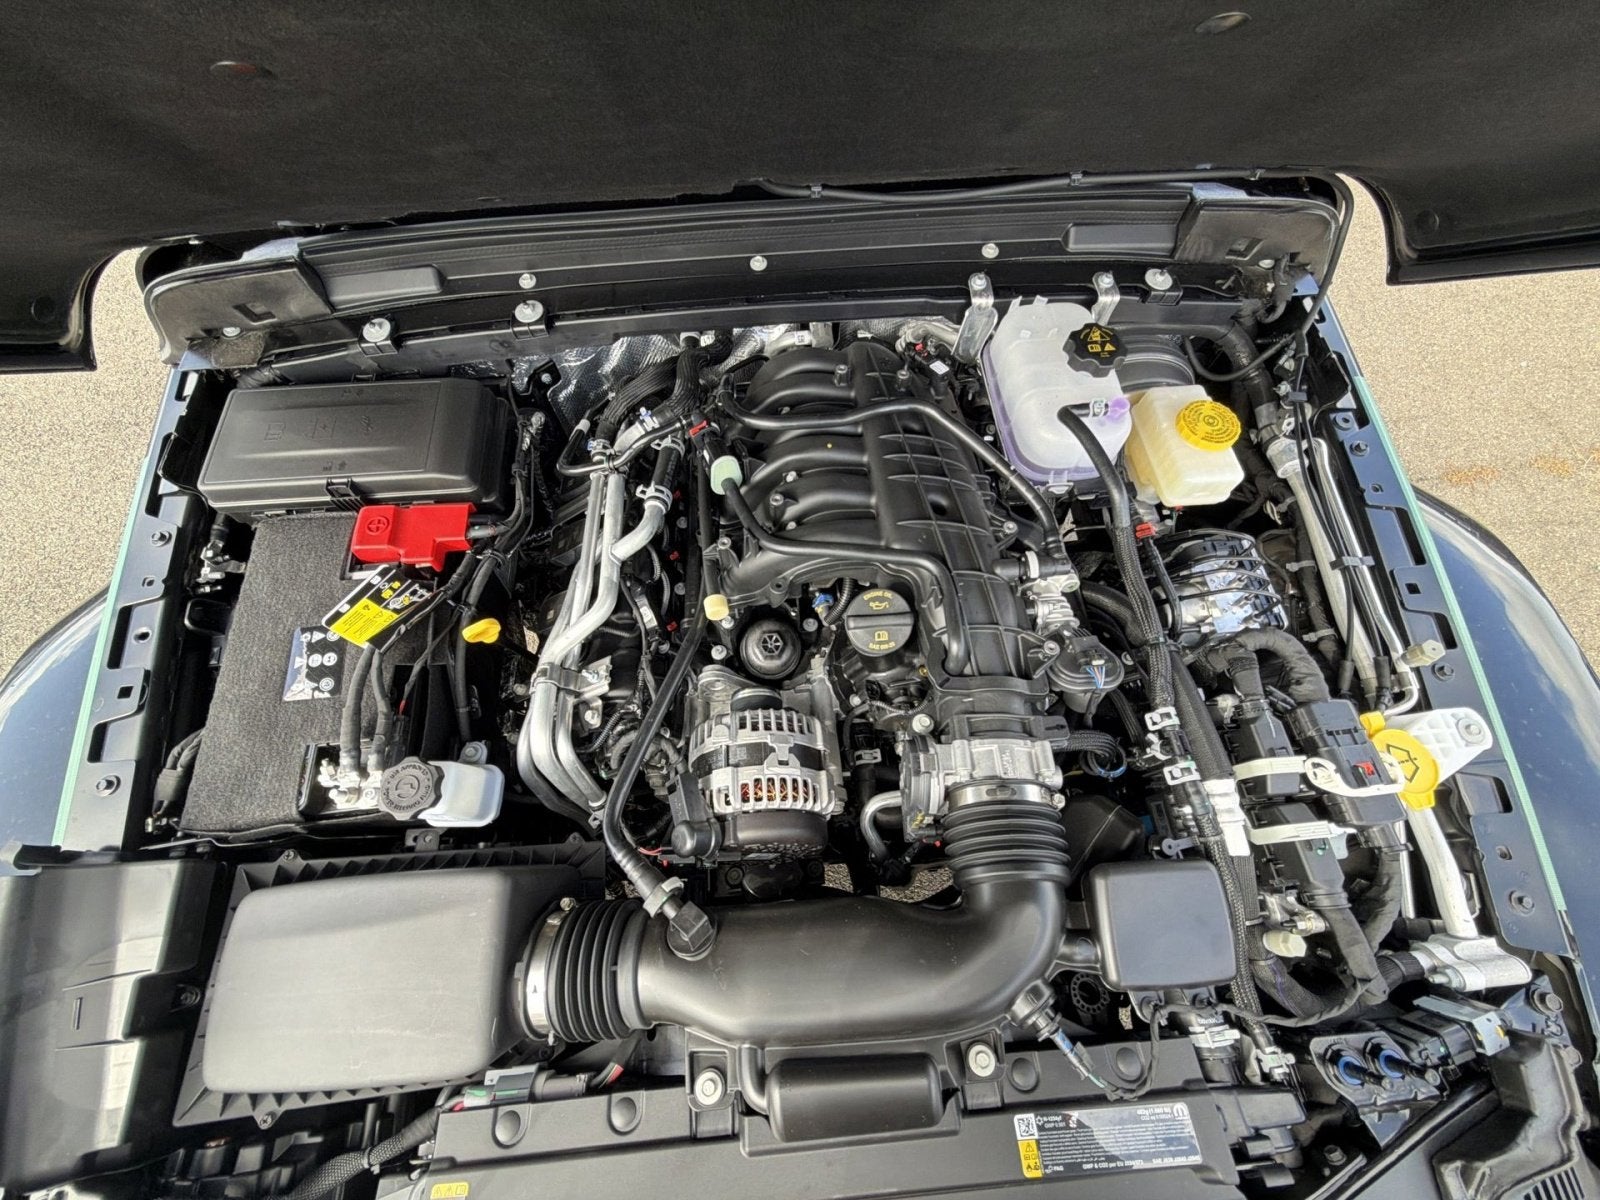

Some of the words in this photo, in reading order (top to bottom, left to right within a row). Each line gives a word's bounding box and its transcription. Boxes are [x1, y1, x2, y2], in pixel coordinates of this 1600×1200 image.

[863, 590, 883, 600] ENGINE
[884, 591, 893, 599] OIL
[869, 642, 880, 650] SAE
